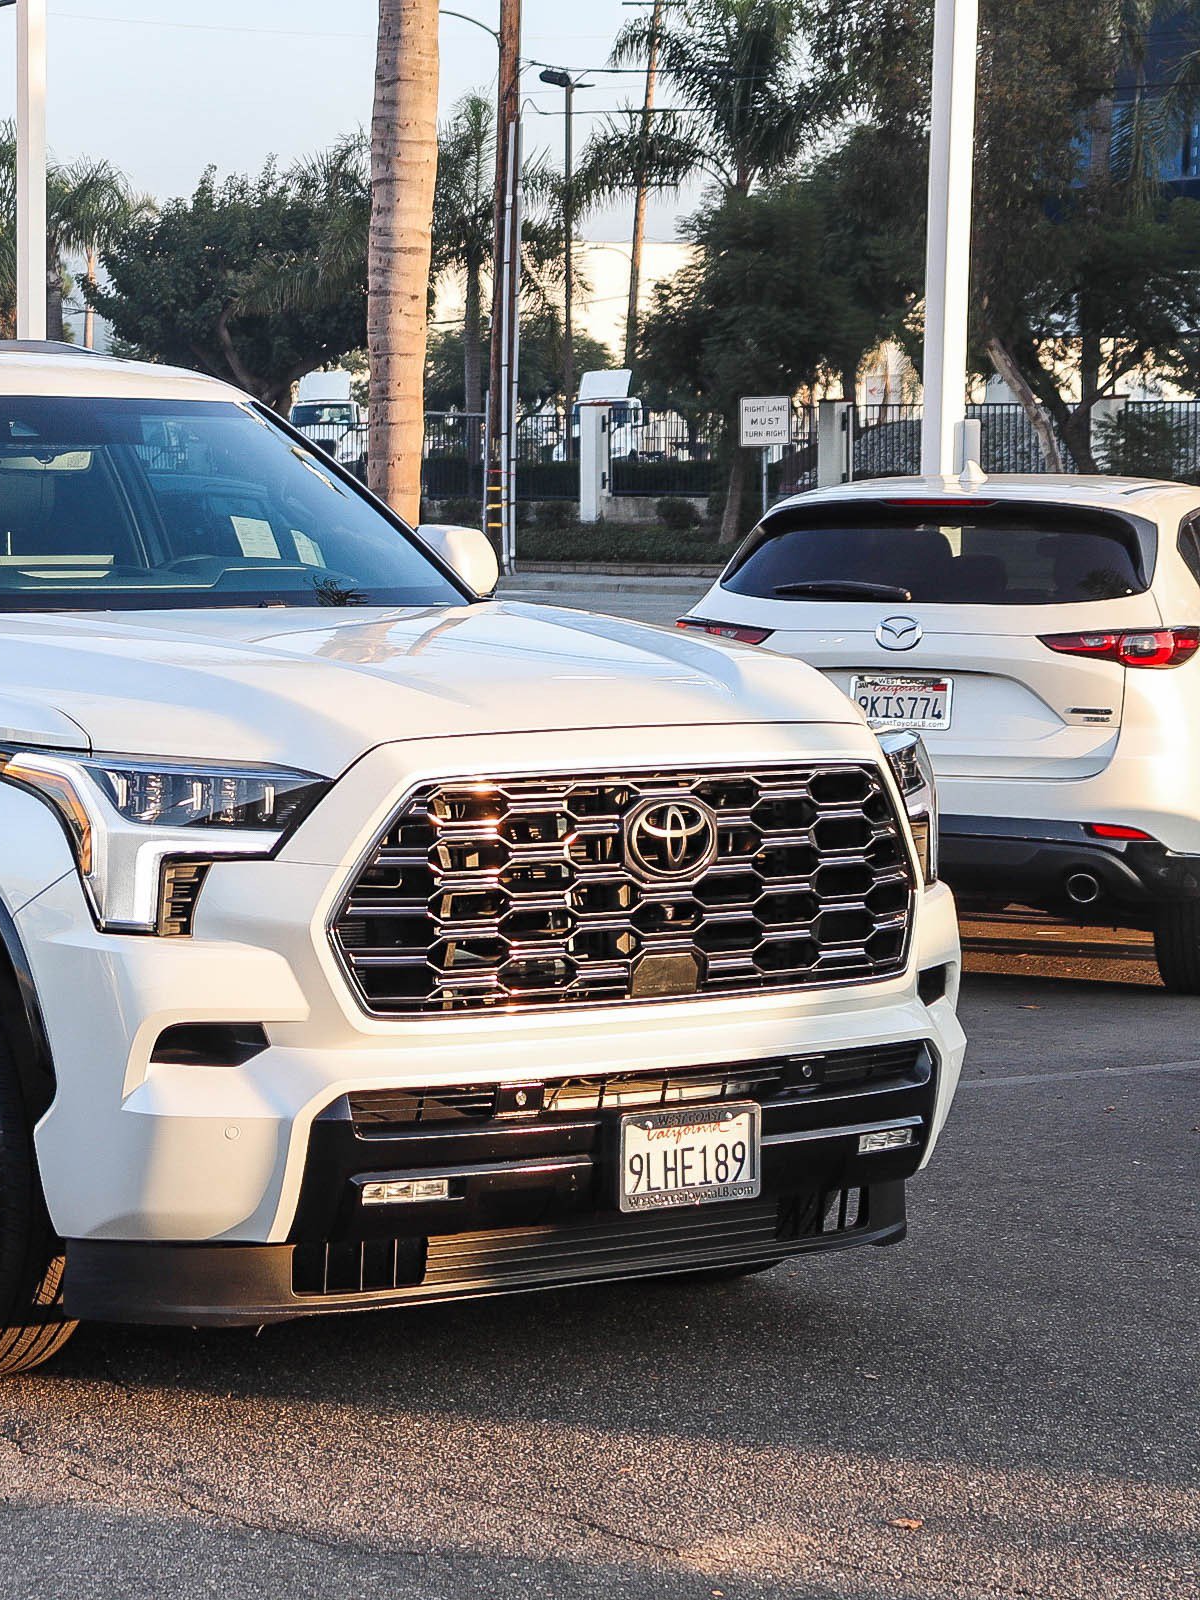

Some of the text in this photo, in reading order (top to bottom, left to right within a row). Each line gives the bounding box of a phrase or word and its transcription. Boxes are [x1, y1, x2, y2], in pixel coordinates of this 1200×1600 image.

[744, 404, 788, 413] RIGHT LANE
[750, 417, 780, 425] MUST
[744, 430, 763, 438] TURN
[858, 696, 943, 719] 9KIS774
[657, 1110, 723, 1126] WEST COAST
[628, 1140, 747, 1194] 9LHE189
